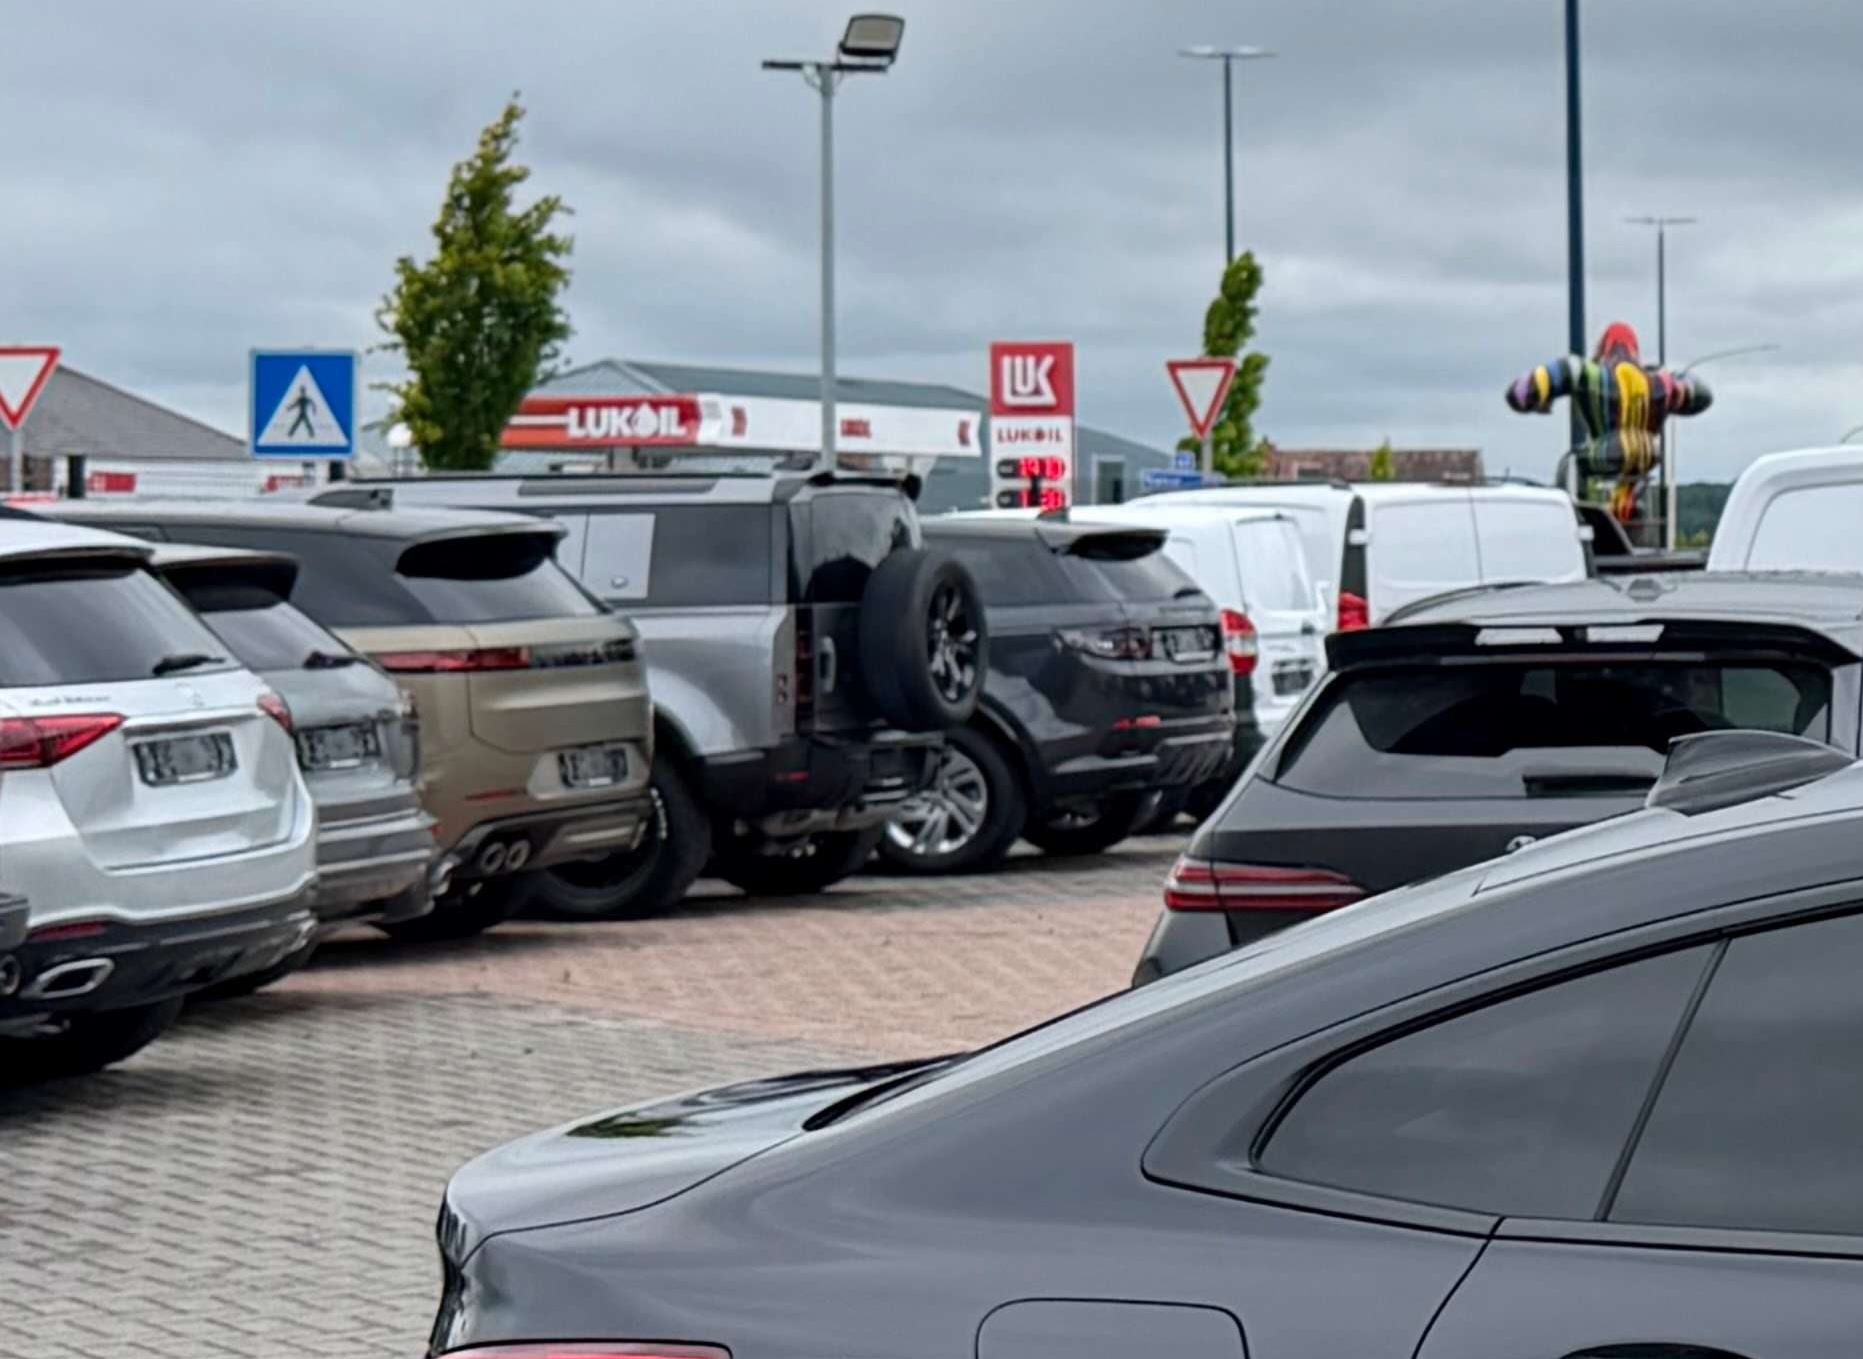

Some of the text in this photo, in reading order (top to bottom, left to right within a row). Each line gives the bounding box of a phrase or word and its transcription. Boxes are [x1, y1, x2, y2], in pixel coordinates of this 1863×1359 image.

[1002, 354, 1057, 406] LUK
[567, 402, 687, 438] LUKOIL
[997, 427, 1063, 443] LUKOIL
